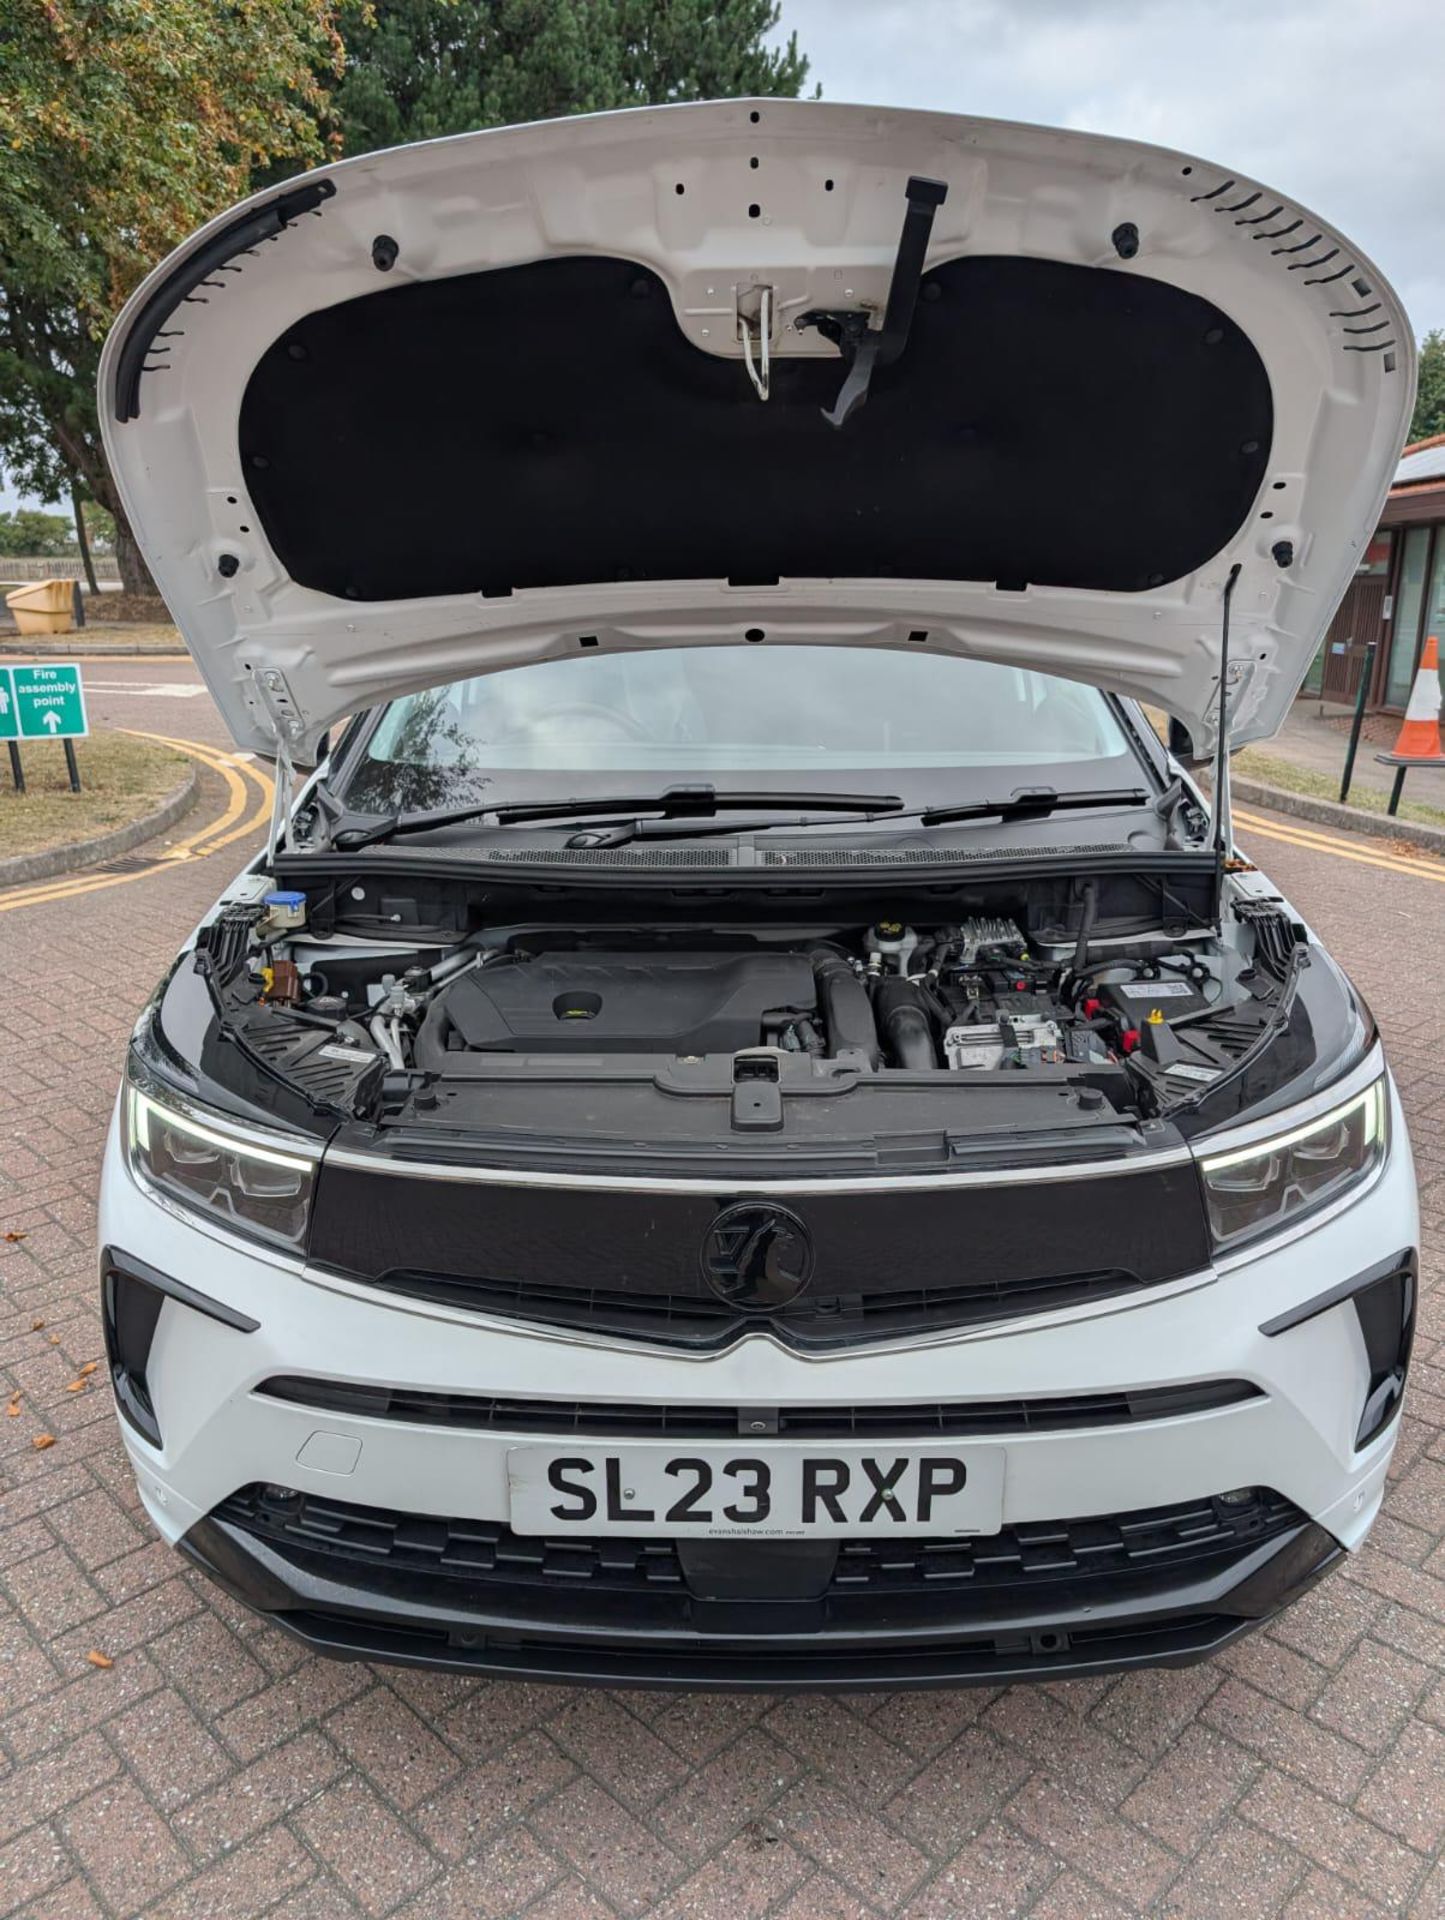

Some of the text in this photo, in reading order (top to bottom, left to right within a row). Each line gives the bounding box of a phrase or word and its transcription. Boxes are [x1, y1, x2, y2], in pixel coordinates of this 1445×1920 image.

[33, 669, 57, 680] Fire
[18, 682, 76, 694] assembly
[33, 696, 65, 709] point
[547, 1457, 967, 1523] SL23 RXP
